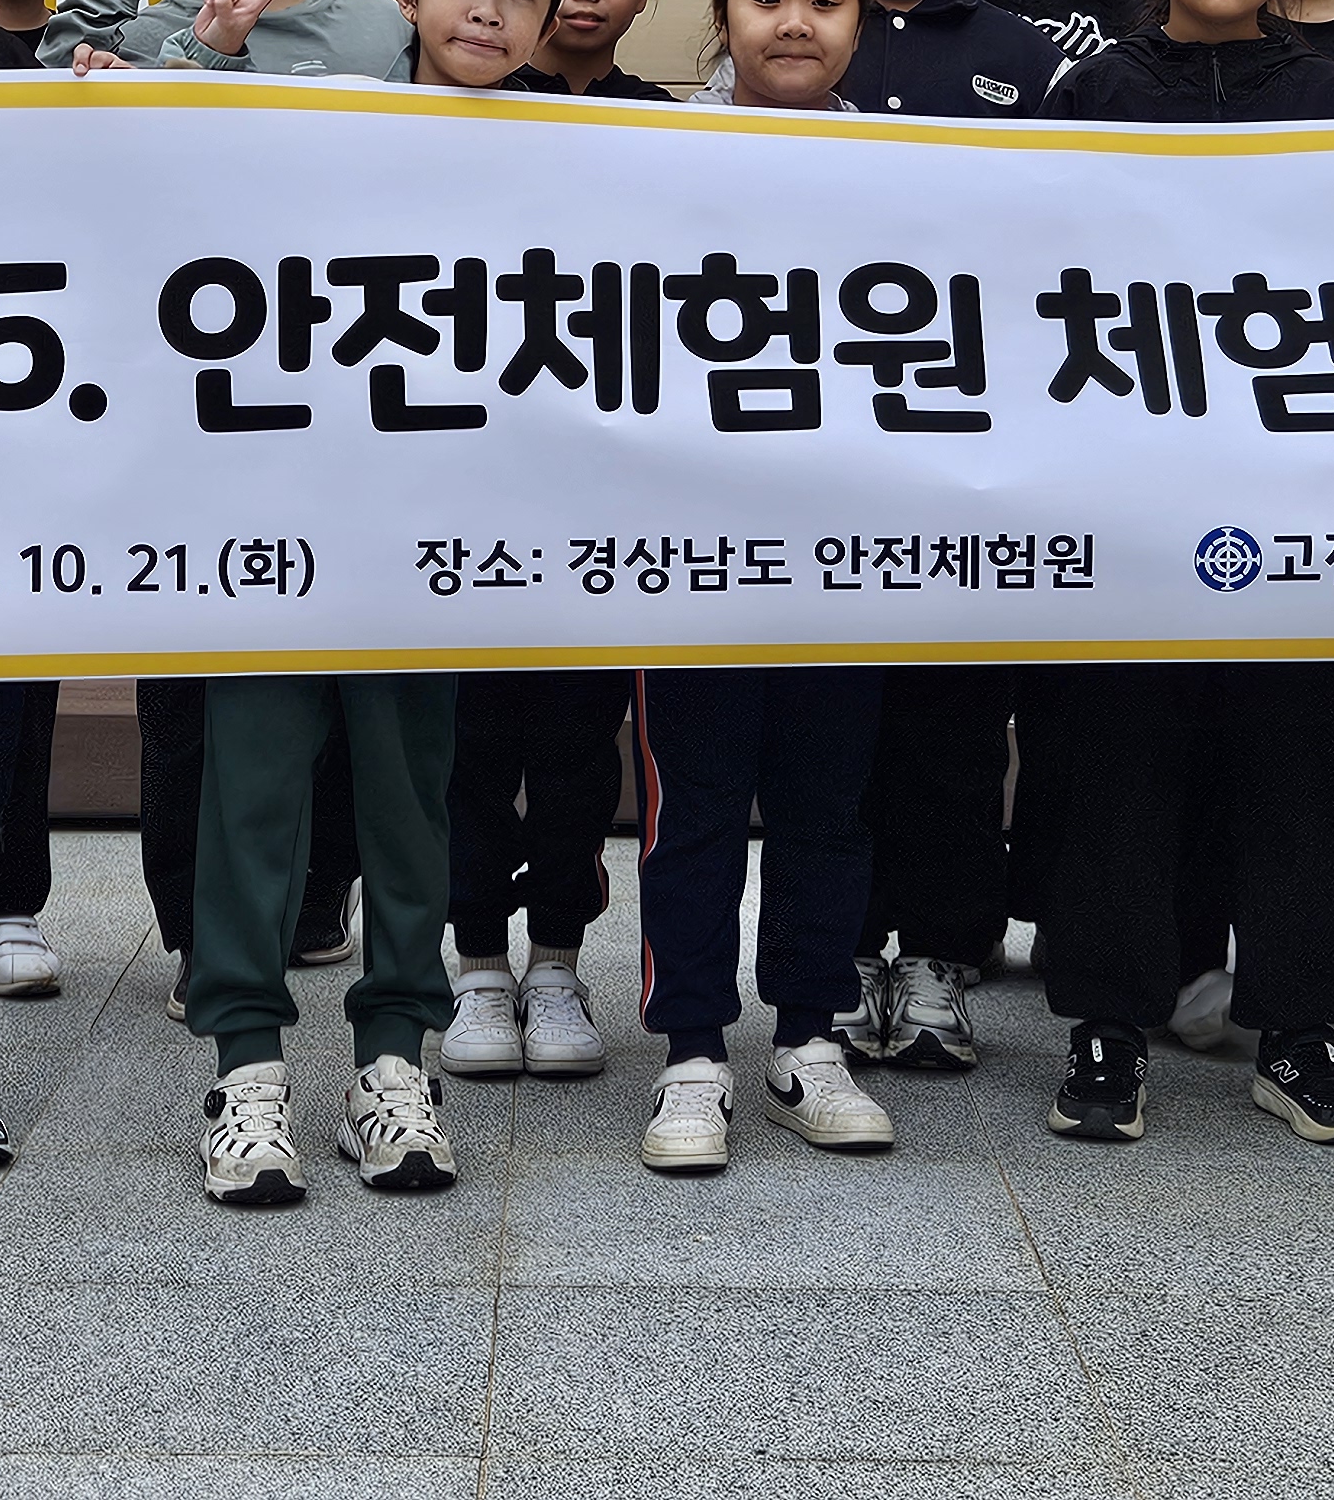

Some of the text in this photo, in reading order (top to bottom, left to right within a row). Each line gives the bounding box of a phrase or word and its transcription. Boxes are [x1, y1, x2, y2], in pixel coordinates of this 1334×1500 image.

[159, 248, 991, 432] 안전체험원
[20, 545, 101, 595] 10.
[128, 539, 314, 597] 21.(화)
[416, 534, 1094, 596] 장소: 경상남도 안전체험원
[1270, 1060, 1299, 1083] N
